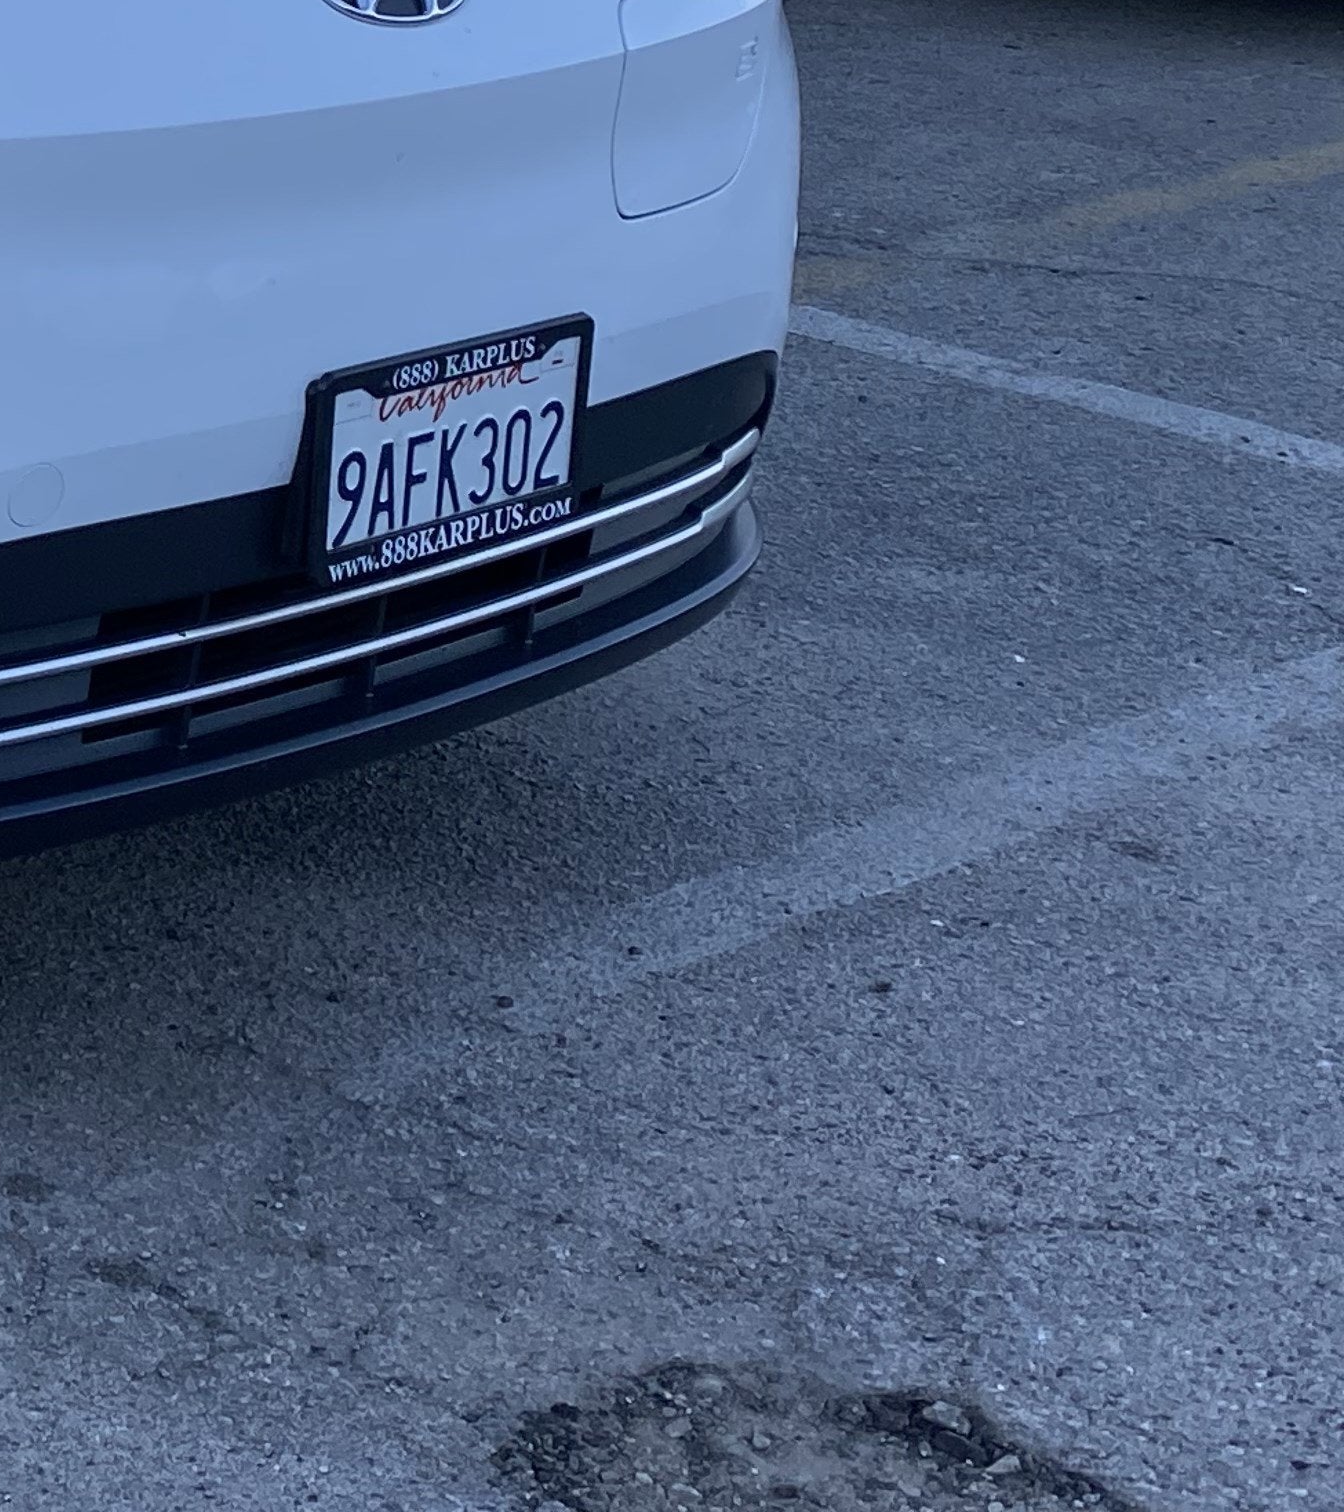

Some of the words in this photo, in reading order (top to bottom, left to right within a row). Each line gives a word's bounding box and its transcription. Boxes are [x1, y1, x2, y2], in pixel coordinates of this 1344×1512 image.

[377, 362, 540, 424] California
[392, 360, 439, 390] (888)
[443, 335, 537, 379] KARPLUS
[330, 399, 566, 549] 9AFK302
